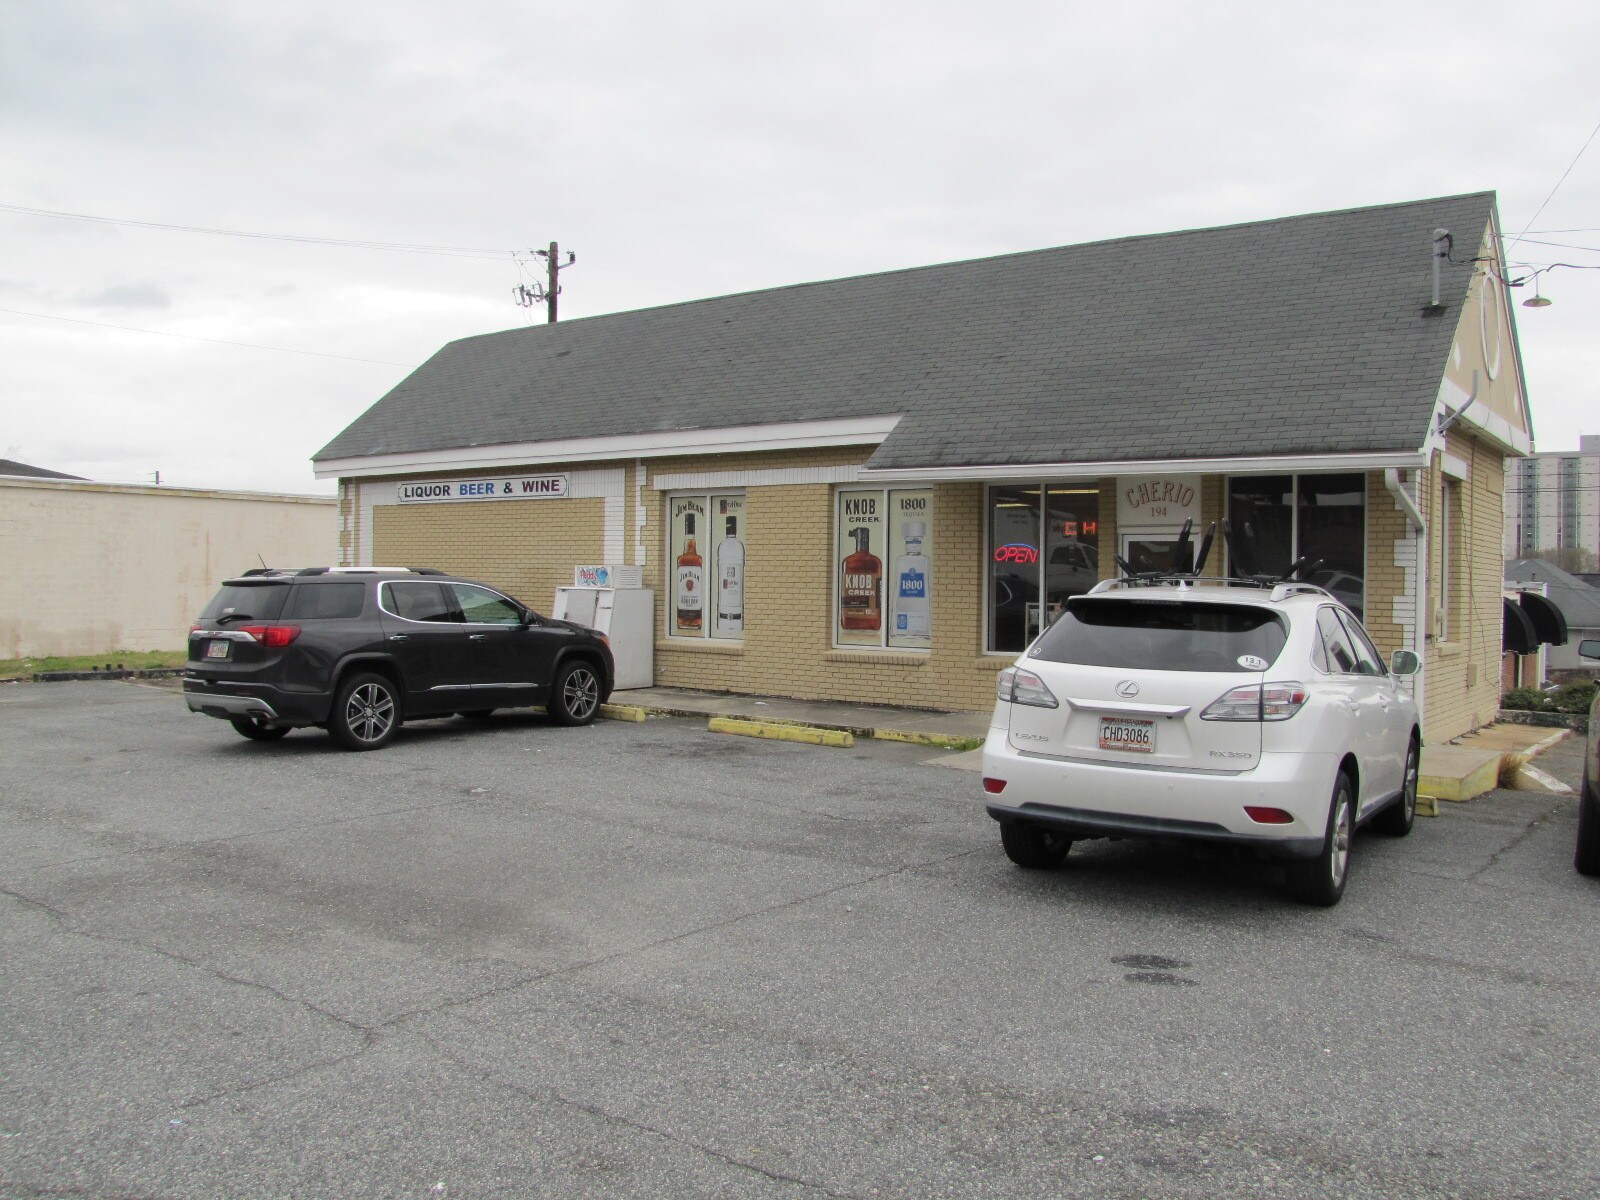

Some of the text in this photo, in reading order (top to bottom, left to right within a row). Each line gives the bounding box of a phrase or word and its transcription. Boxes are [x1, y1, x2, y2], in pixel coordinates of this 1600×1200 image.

[404, 479, 560, 498] LIQUOR BEER & WINE
[1125, 481, 1194, 509] CHERIO
[676, 503, 687, 518] JIM
[687, 500, 704, 517] BEAM
[845, 498, 876, 515] KNOB
[900, 498, 926, 510] 1800
[1151, 506, 1167, 517] 194
[994, 546, 1038, 563] OPEN
[845, 574, 872, 589] KNOB
[902, 580, 923, 590] 1800
[1103, 726, 1149, 744] CHD3086
[1209, 750, 1252, 759] RX 350
